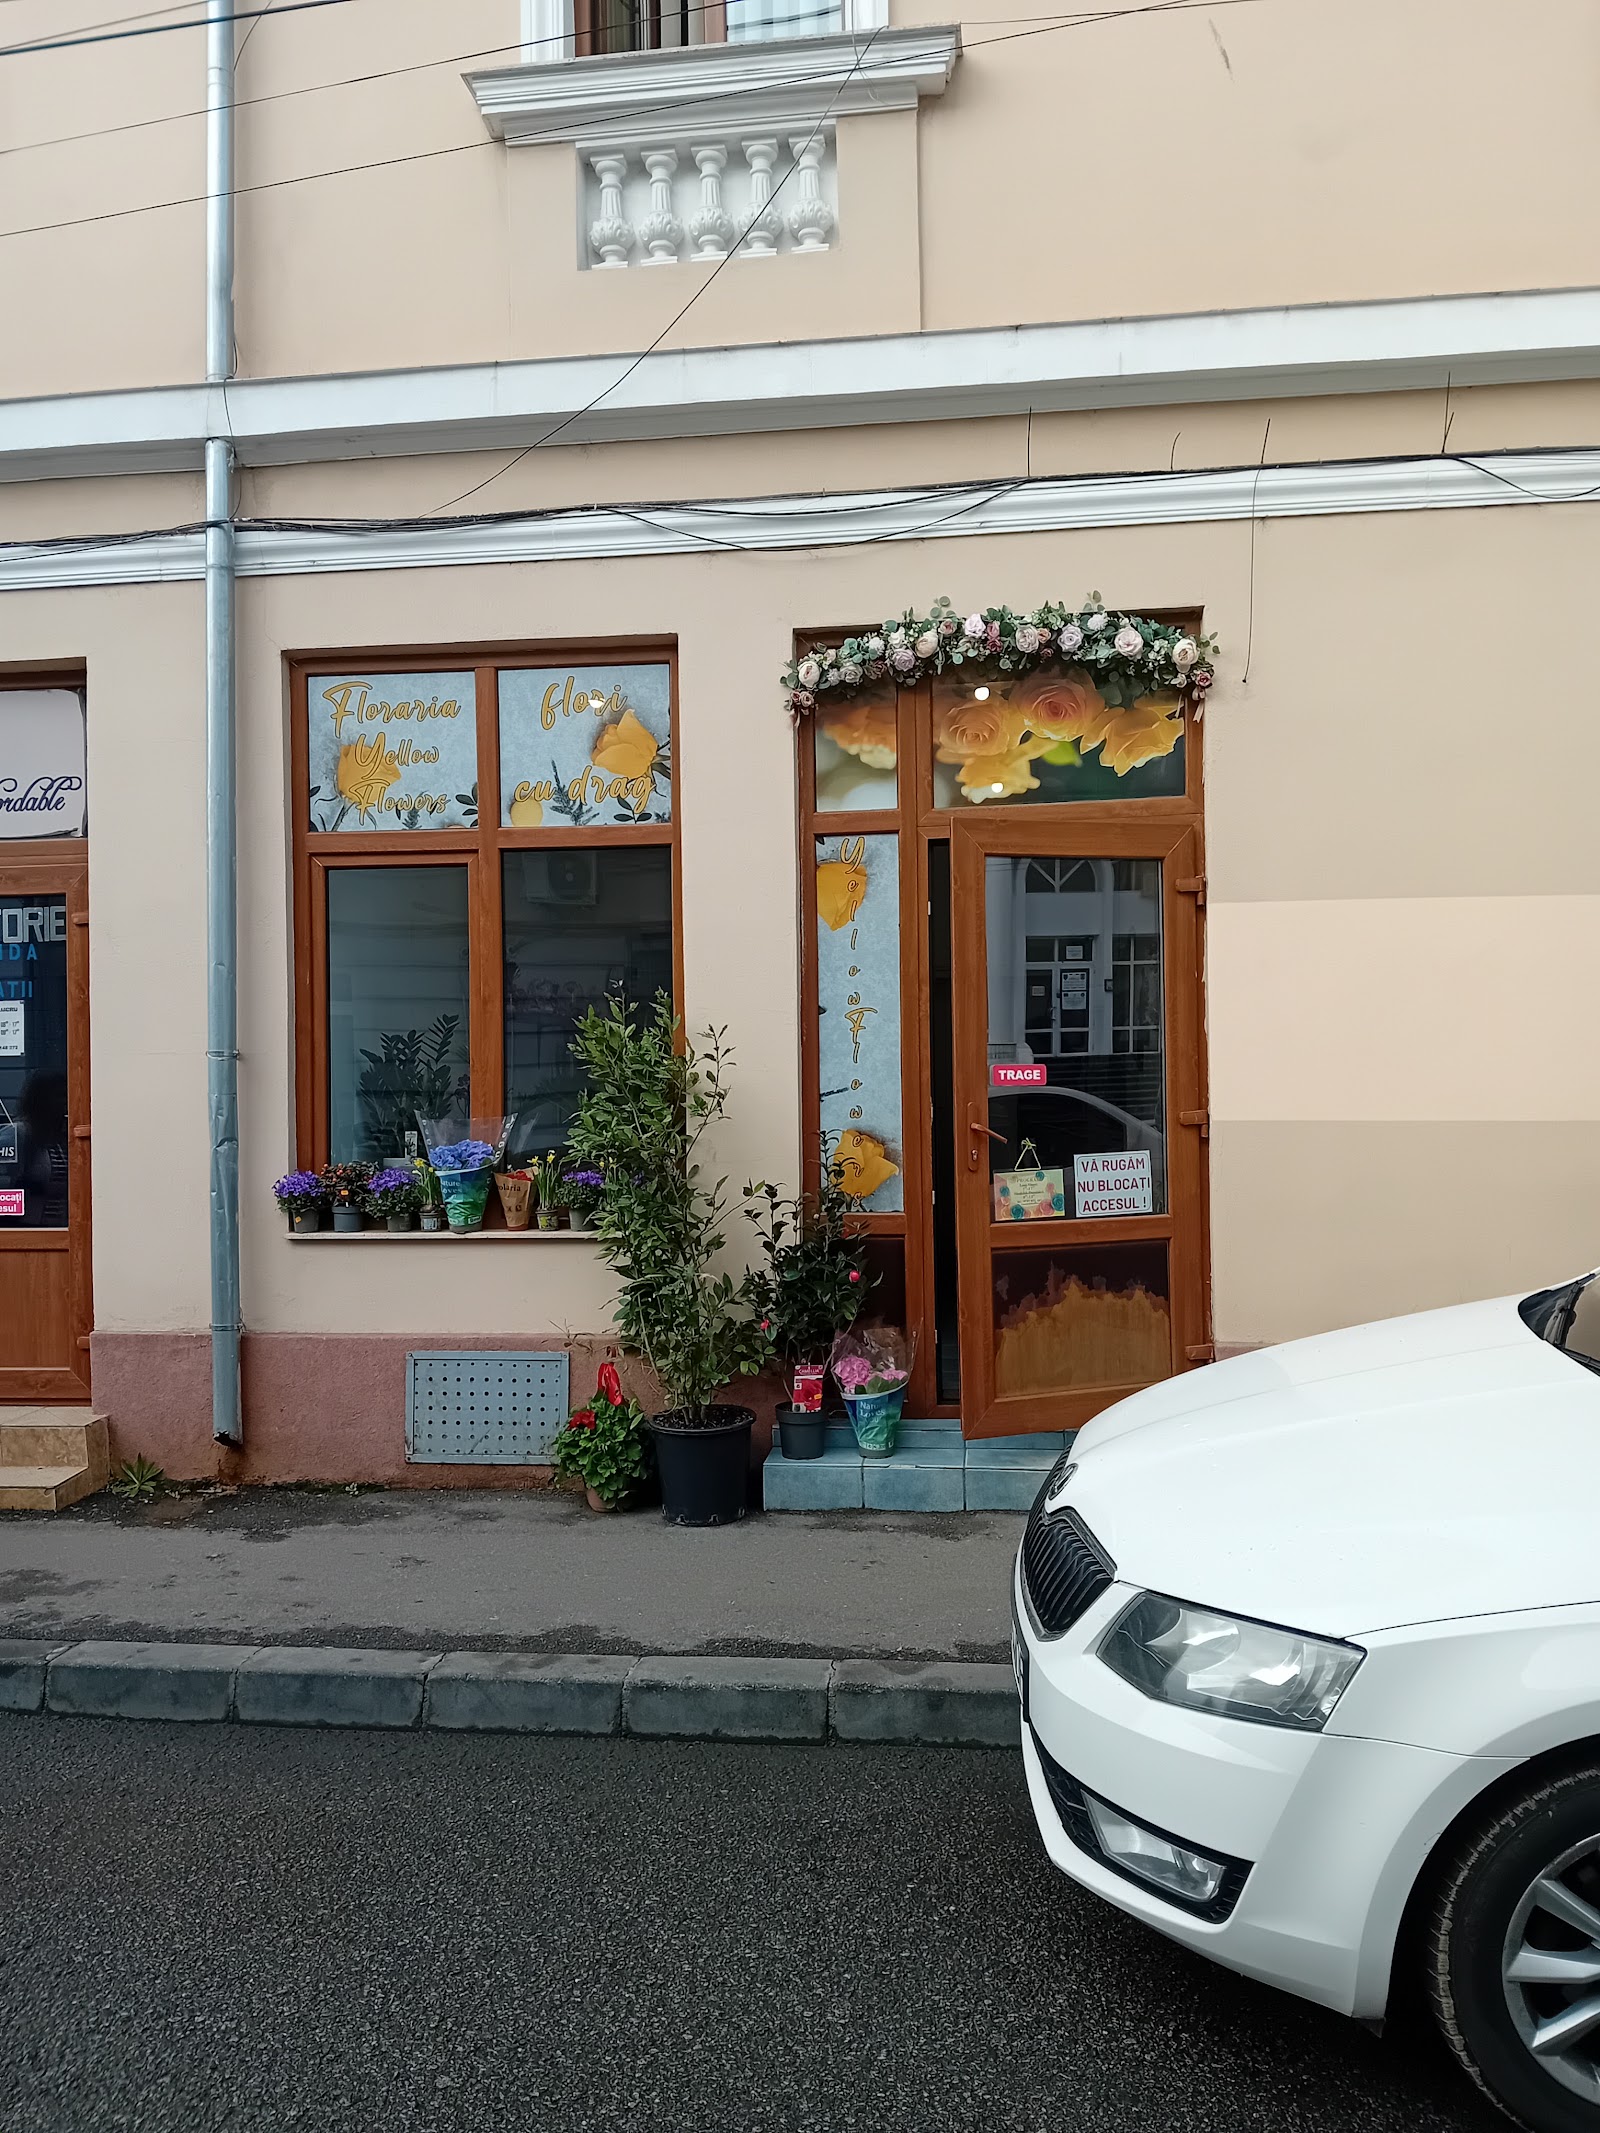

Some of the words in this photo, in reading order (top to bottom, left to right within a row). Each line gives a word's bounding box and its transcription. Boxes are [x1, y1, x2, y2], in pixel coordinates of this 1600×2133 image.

[322, 680, 462, 738] Floraria
[541, 676, 629, 730] flori
[355, 732, 440, 780] Yellow
[349, 778, 451, 826] Flowers
[514, 780, 555, 803] cu
[568, 765, 656, 814] drag
[0, 905, 66, 943] ORIE
[998, 1069, 1041, 1081] TRAGE
[1081, 1159, 1098, 1173] VĂ
[1102, 1156, 1145, 1172] RUGĂM
[0, 1192, 22, 1204] ocați
[1077, 1180, 1094, 1193] NU
[1097, 1177, 1150, 1192] BLOCAȚI
[1082, 1197, 1140, 1212] ACCESUL
